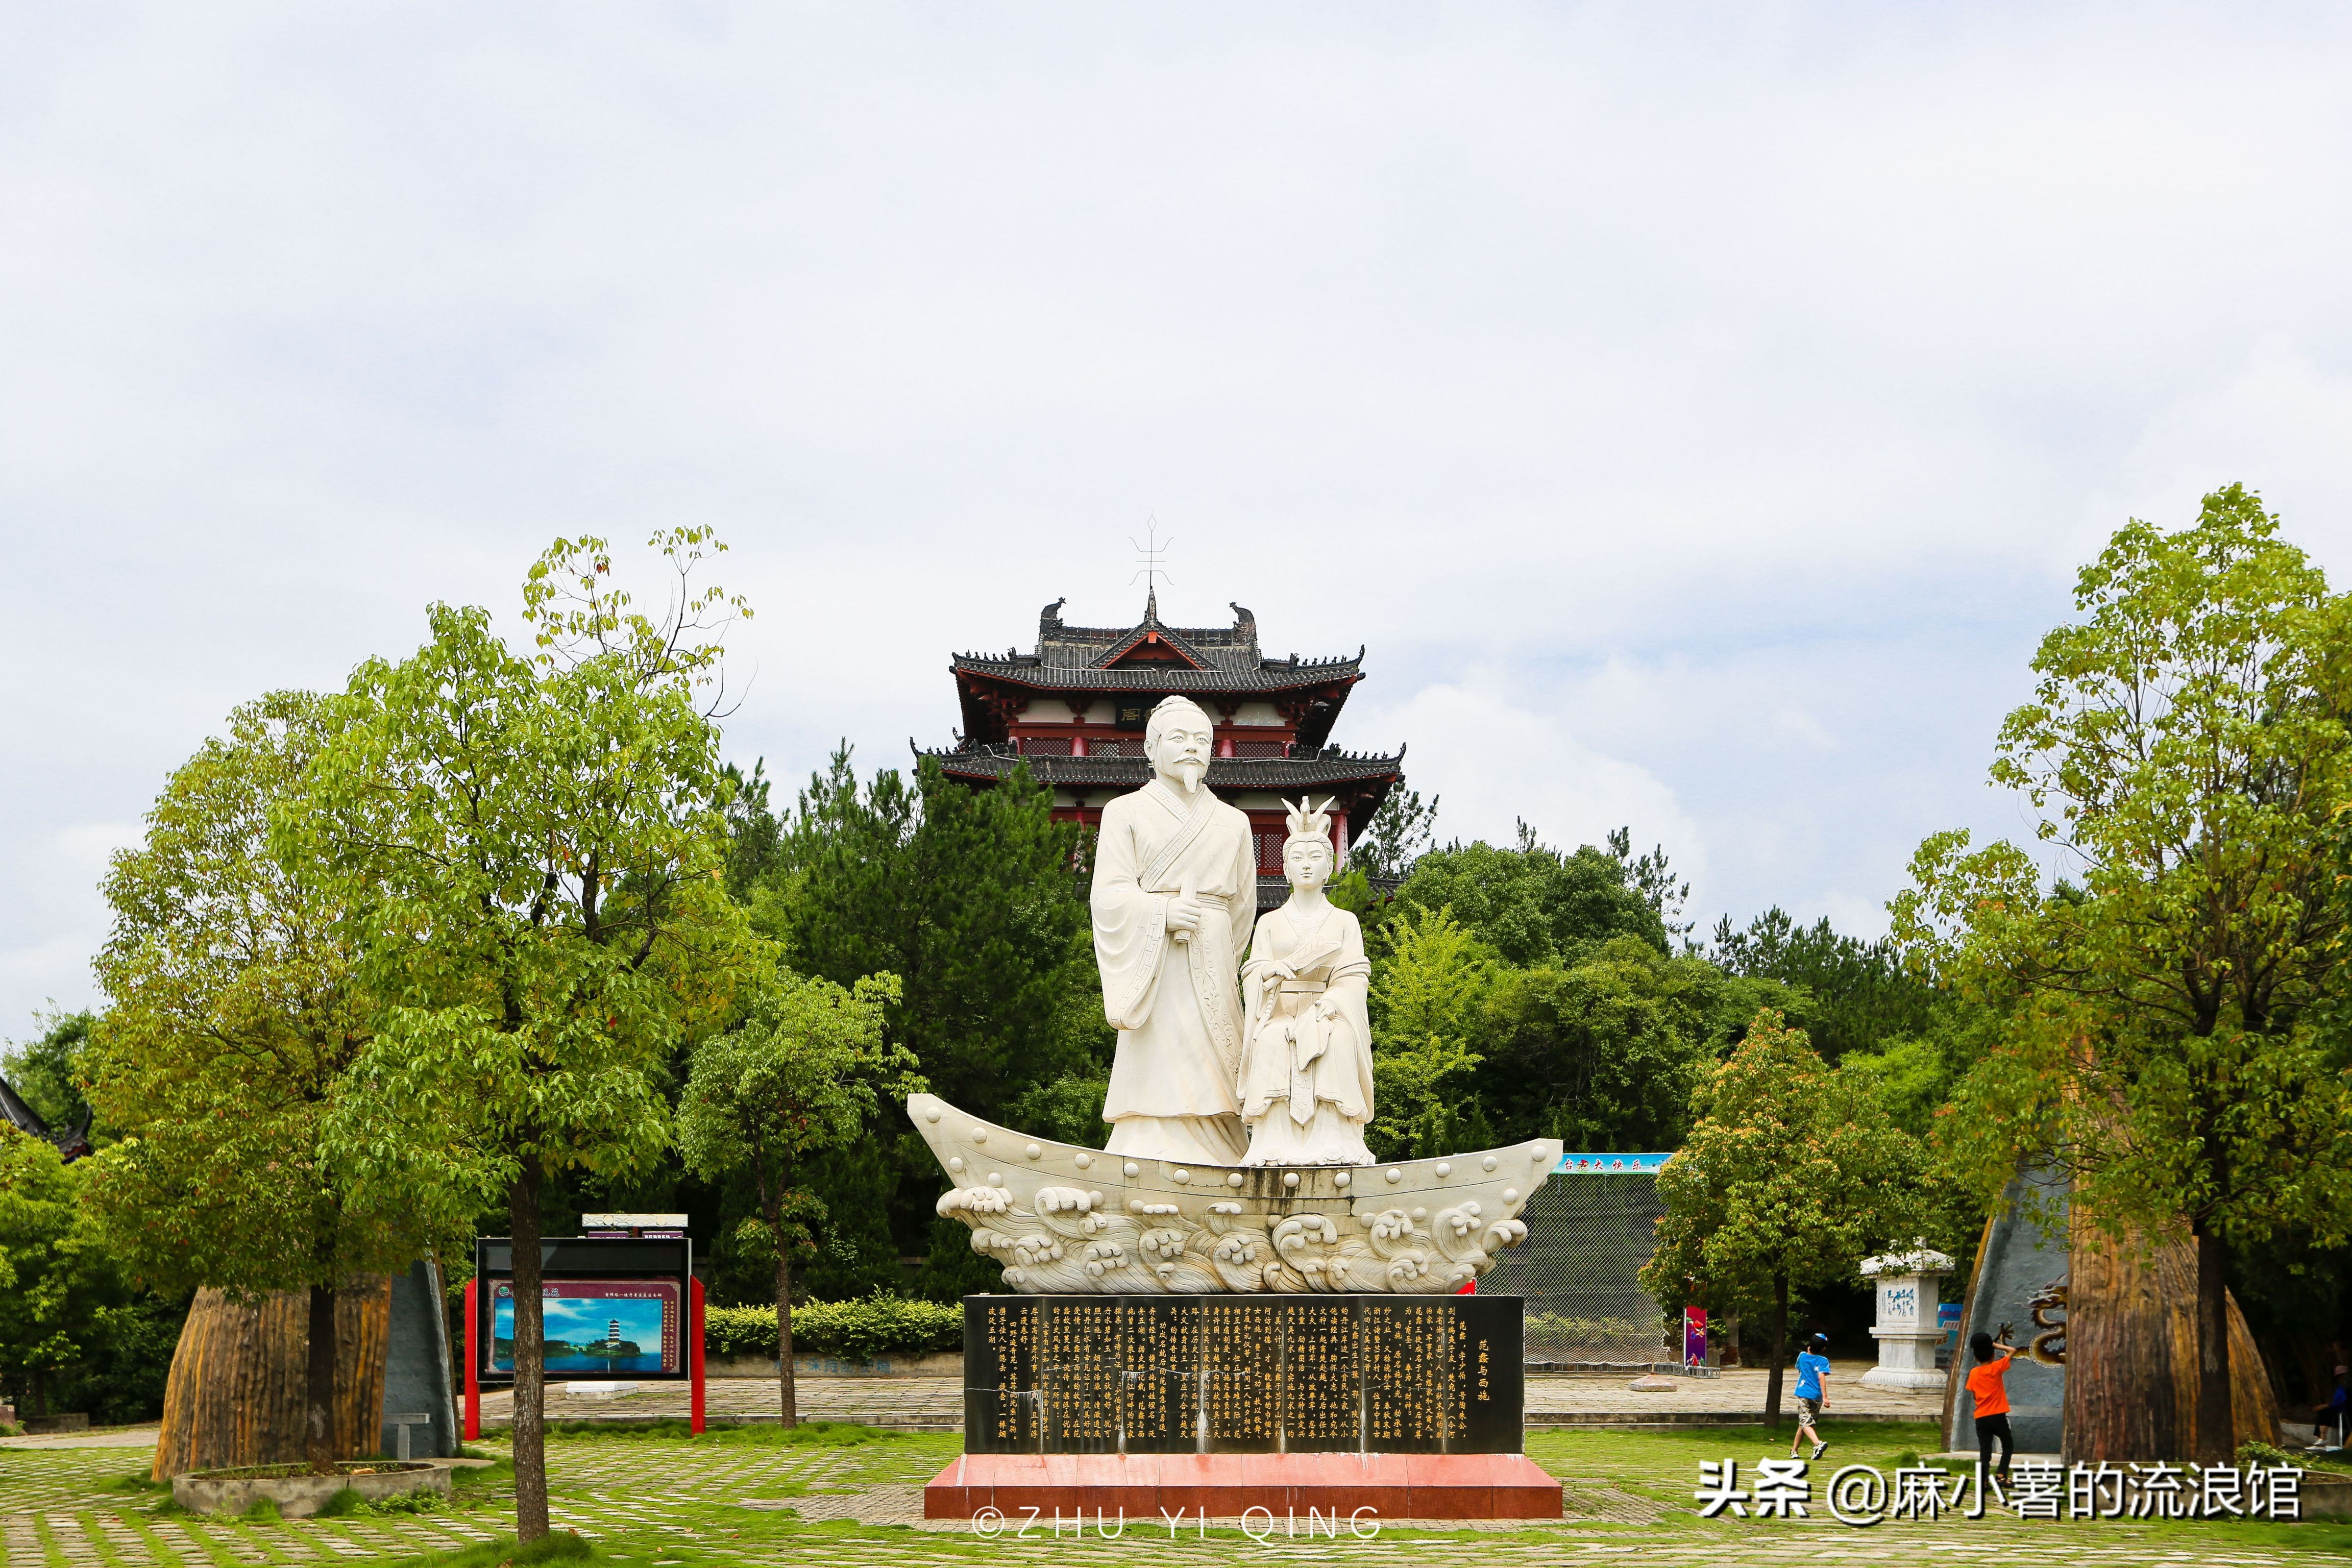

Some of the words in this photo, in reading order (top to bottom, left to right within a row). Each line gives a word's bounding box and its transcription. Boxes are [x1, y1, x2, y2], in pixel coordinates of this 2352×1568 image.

[1478, 1339, 1489, 1400] 范蠡与西施
